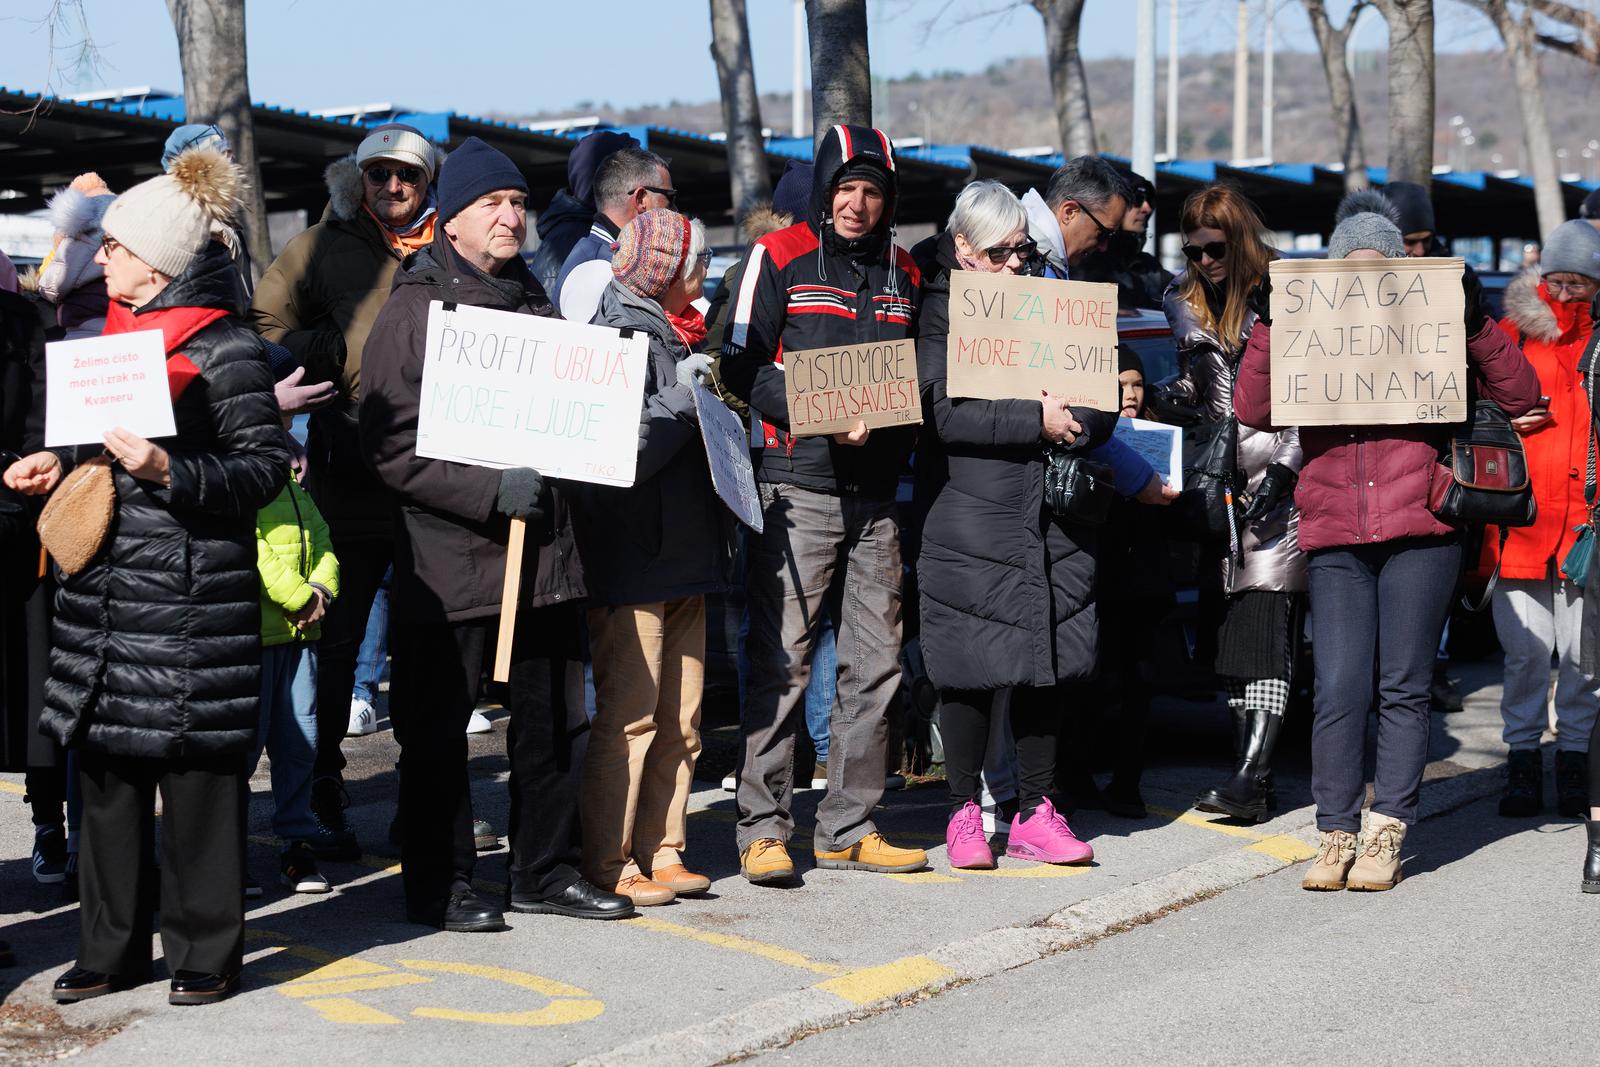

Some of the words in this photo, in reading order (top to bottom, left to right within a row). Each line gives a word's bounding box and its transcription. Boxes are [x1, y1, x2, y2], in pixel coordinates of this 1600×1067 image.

[963, 288, 1005, 319] SVI
[1012, 293, 1046, 324] ZA
[1055, 298, 1113, 328] MORE
[1285, 272, 1429, 314] SNAGA
[438, 328, 546, 375] PROFIT
[554, 343, 629, 388] UBIJA
[957, 336, 1021, 367] MORE
[1028, 342, 1056, 369] ZA
[1064, 344, 1113, 373] SVIH
[1282, 322, 1451, 358] ZAJEDNICE
[69, 377, 97, 389] more
[106, 372, 129, 384] zrak
[132, 372, 145, 381] na
[793, 350, 853, 393] ČISTO
[857, 343, 905, 385] MORE
[1280, 373, 1308, 403] JE
[1325, 372, 1343, 402] U
[1355, 371, 1461, 401] NAMA
[84, 393, 134, 406] Kvarneru
[429, 382, 511, 429] MORE
[525, 394, 605, 442] LJUDE
[793, 390, 849, 426] ČISTA
[849, 380, 916, 415] SAVJEST
[894, 410, 911, 422] TIR
